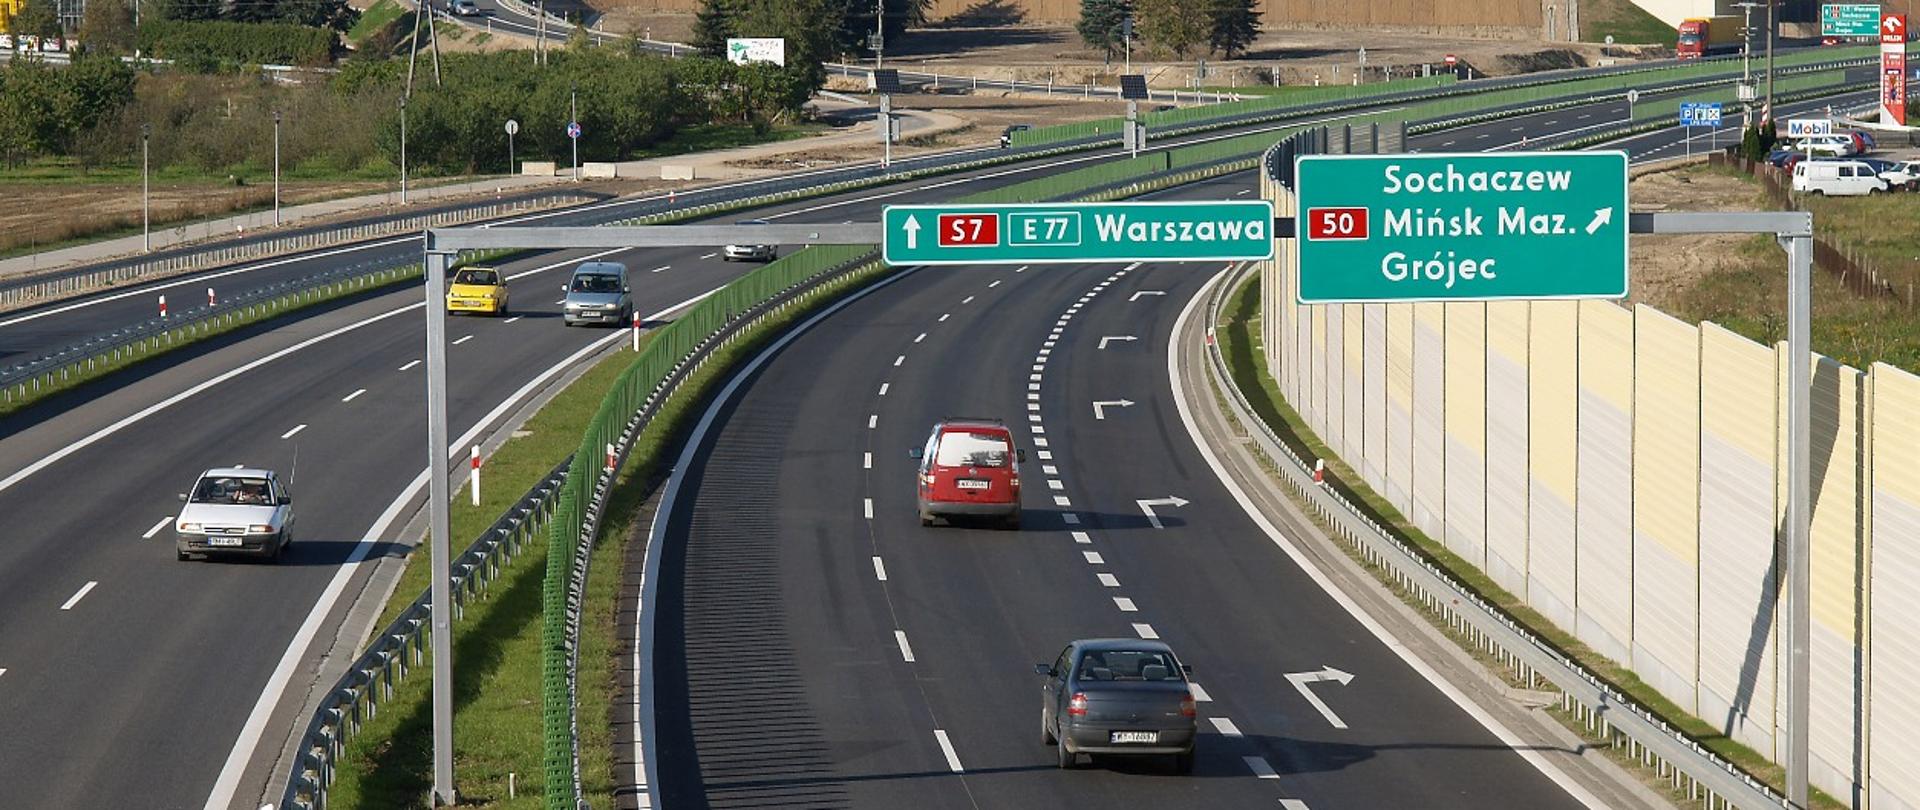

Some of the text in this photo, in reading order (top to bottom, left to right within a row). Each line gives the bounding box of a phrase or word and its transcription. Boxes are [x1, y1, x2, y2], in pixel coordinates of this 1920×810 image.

[1791, 122, 1829, 135] Mobil
[1383, 164, 1572, 194] Sochaczew
[1095, 214, 1265, 242] Warszawa
[1322, 212, 1354, 235] 50
[1383, 206, 1576, 237] Mińsk Maz.
[1382, 251, 1497, 289] Grójec
